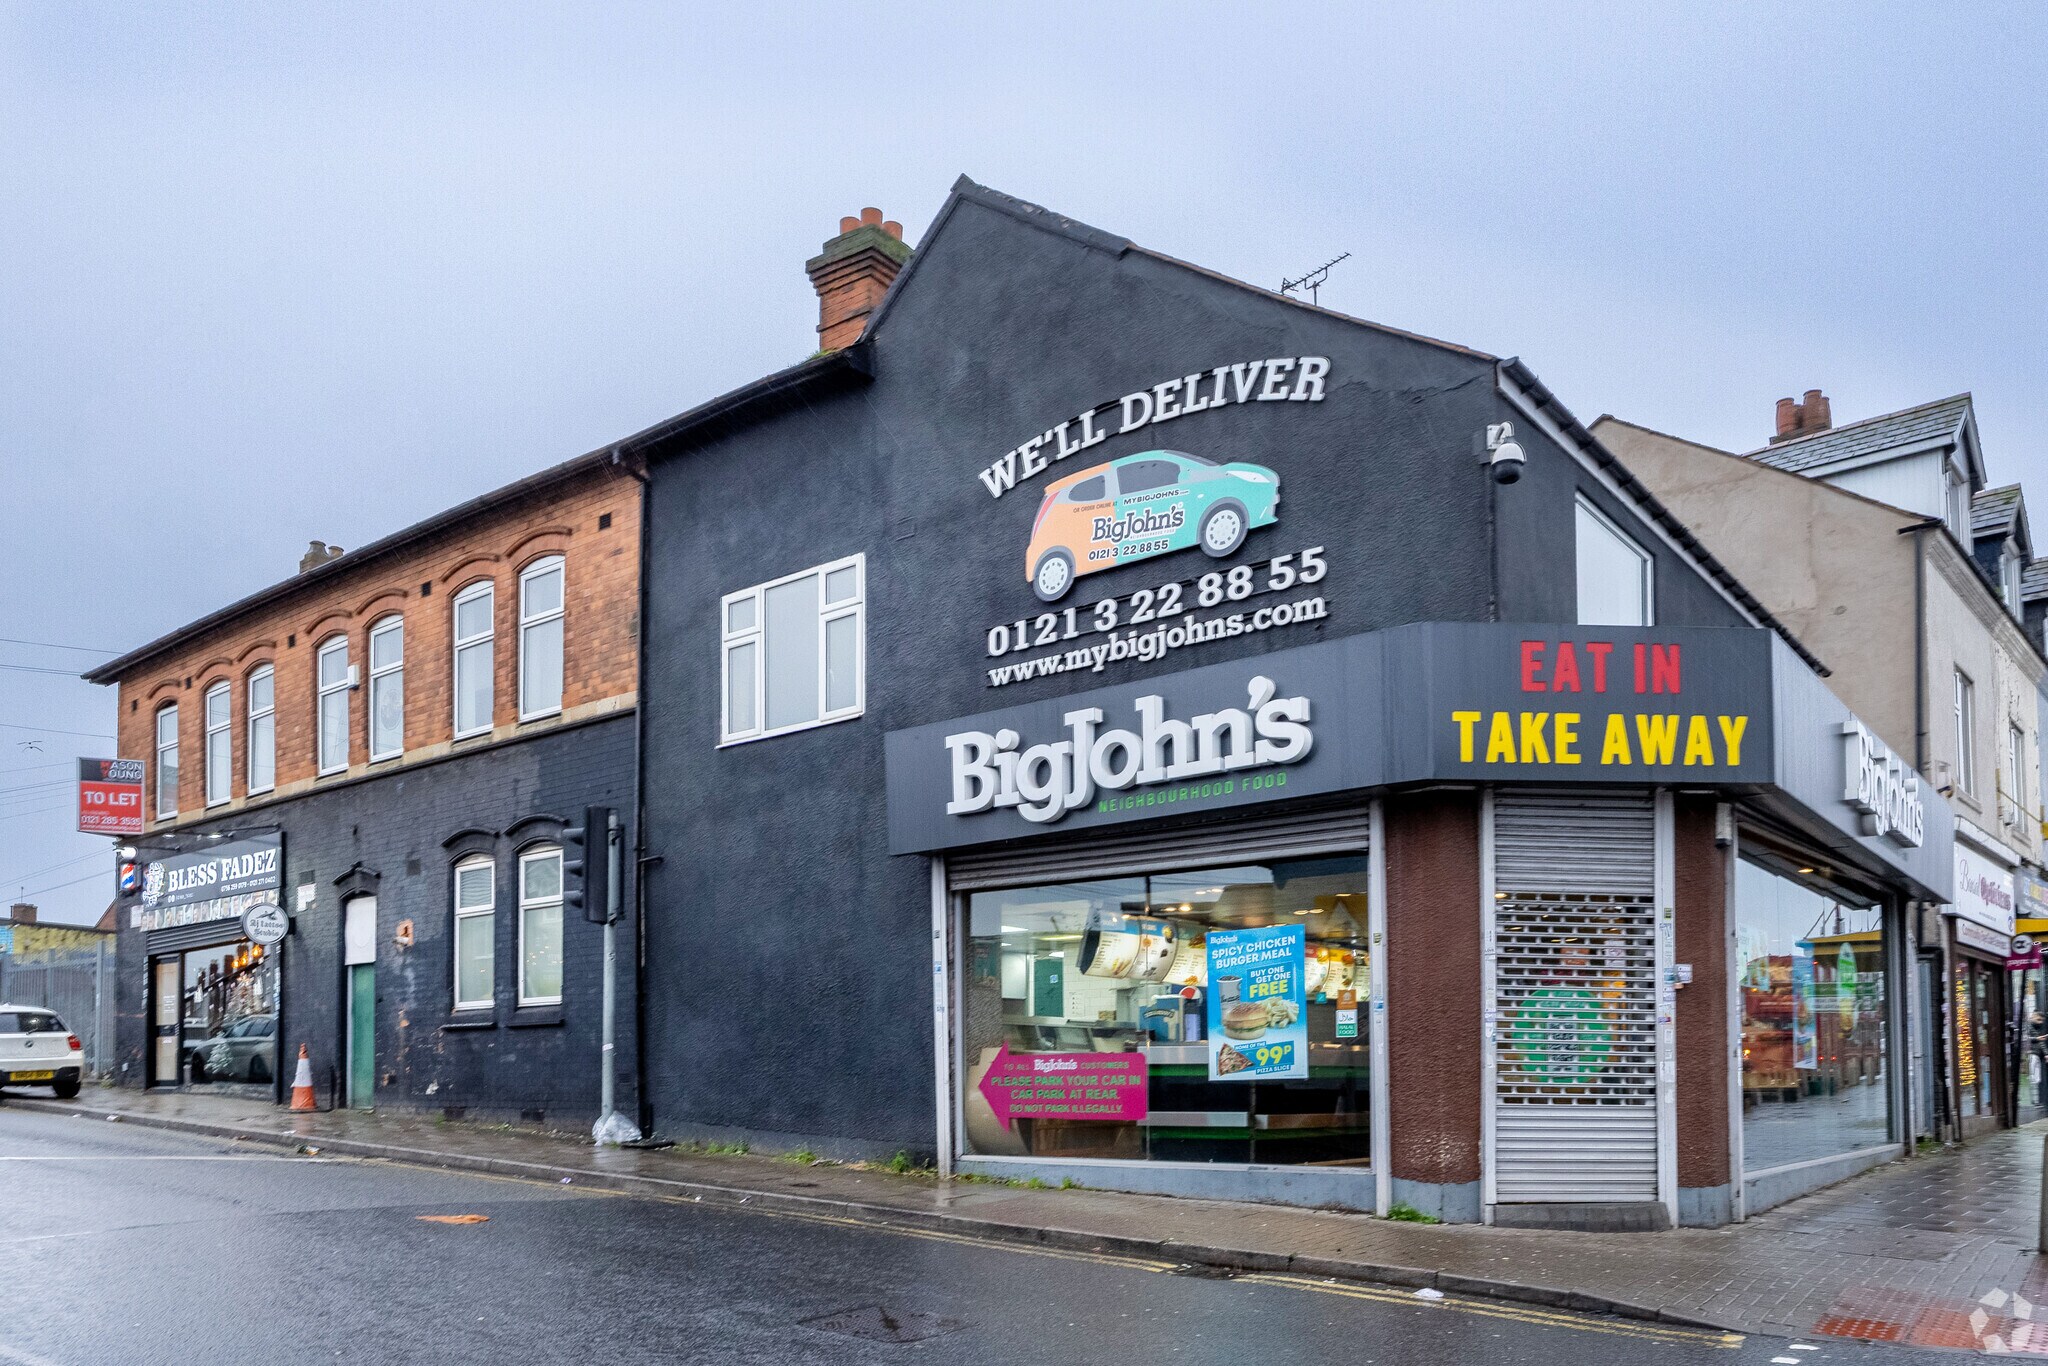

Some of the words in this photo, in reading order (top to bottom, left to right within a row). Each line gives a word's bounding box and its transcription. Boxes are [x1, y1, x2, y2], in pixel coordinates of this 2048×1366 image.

[978, 409, 1106, 498] WE'LL
[1119, 356, 1331, 434] DELIVER
[1092, 505, 1184, 542] BigJohn's
[1088, 549, 1110, 560] 0121
[1111, 547, 1119, 557] 3
[1122, 545, 1137, 556] 22
[987, 607, 1080, 656] 0121
[1095, 599, 1118, 631] 3
[1130, 583, 1183, 624] 22
[1198, 565, 1253, 607] 88
[1268, 546, 1327, 591] 55
[988, 597, 1327, 686] www.mybigjohns.com
[1520, 640, 1614, 693] EAT
[1634, 643, 1681, 695] IN
[945, 675, 1313, 823] BigJohn's
[1452, 711, 1581, 764] TAKE
[1600, 714, 1748, 766] AWAY
[83, 791, 106, 805] TO
[108, 792, 139, 806] LET
[1098, 780, 1234, 813] NEIGHBOURHOOD
[1242, 772, 1287, 791] FOOD
[168, 861, 218, 893] BLESS
[221, 848, 276, 882] FADEZ
[1212, 945, 1244, 959] SPICY
[1246, 935, 1296, 952] CHICKEN
[1216, 952, 1260, 969] BURGER
[1261, 947, 1292, 961] MEAL
[1250, 968, 1266, 978] BUY
[1267, 965, 1284, 975] ONE
[1256, 974, 1272, 983] GET
[1273, 971, 1291, 980] ONE
[1249, 979, 1288, 998] FREE
[1256, 1066, 1273, 1074] PIZZA
[1274, 1064, 1290, 1072] SLICE
[991, 1075, 1032, 1087] PLEASE
[1034, 1075, 1064, 1086] PARK
[1067, 1075, 1099, 1086] YOUR
[1102, 1075, 1126, 1086] CAR
[1129, 1075, 1140, 1086] IN
[1011, 1089, 1033, 1100] CAR
[1037, 1089, 1066, 1100] PARK
[1069, 1089, 1083, 1100] AT
[1009, 1103, 1022, 1113] DO
[1025, 1103, 1043, 1113] NOT
[1045, 1103, 1069, 1113] PARK
